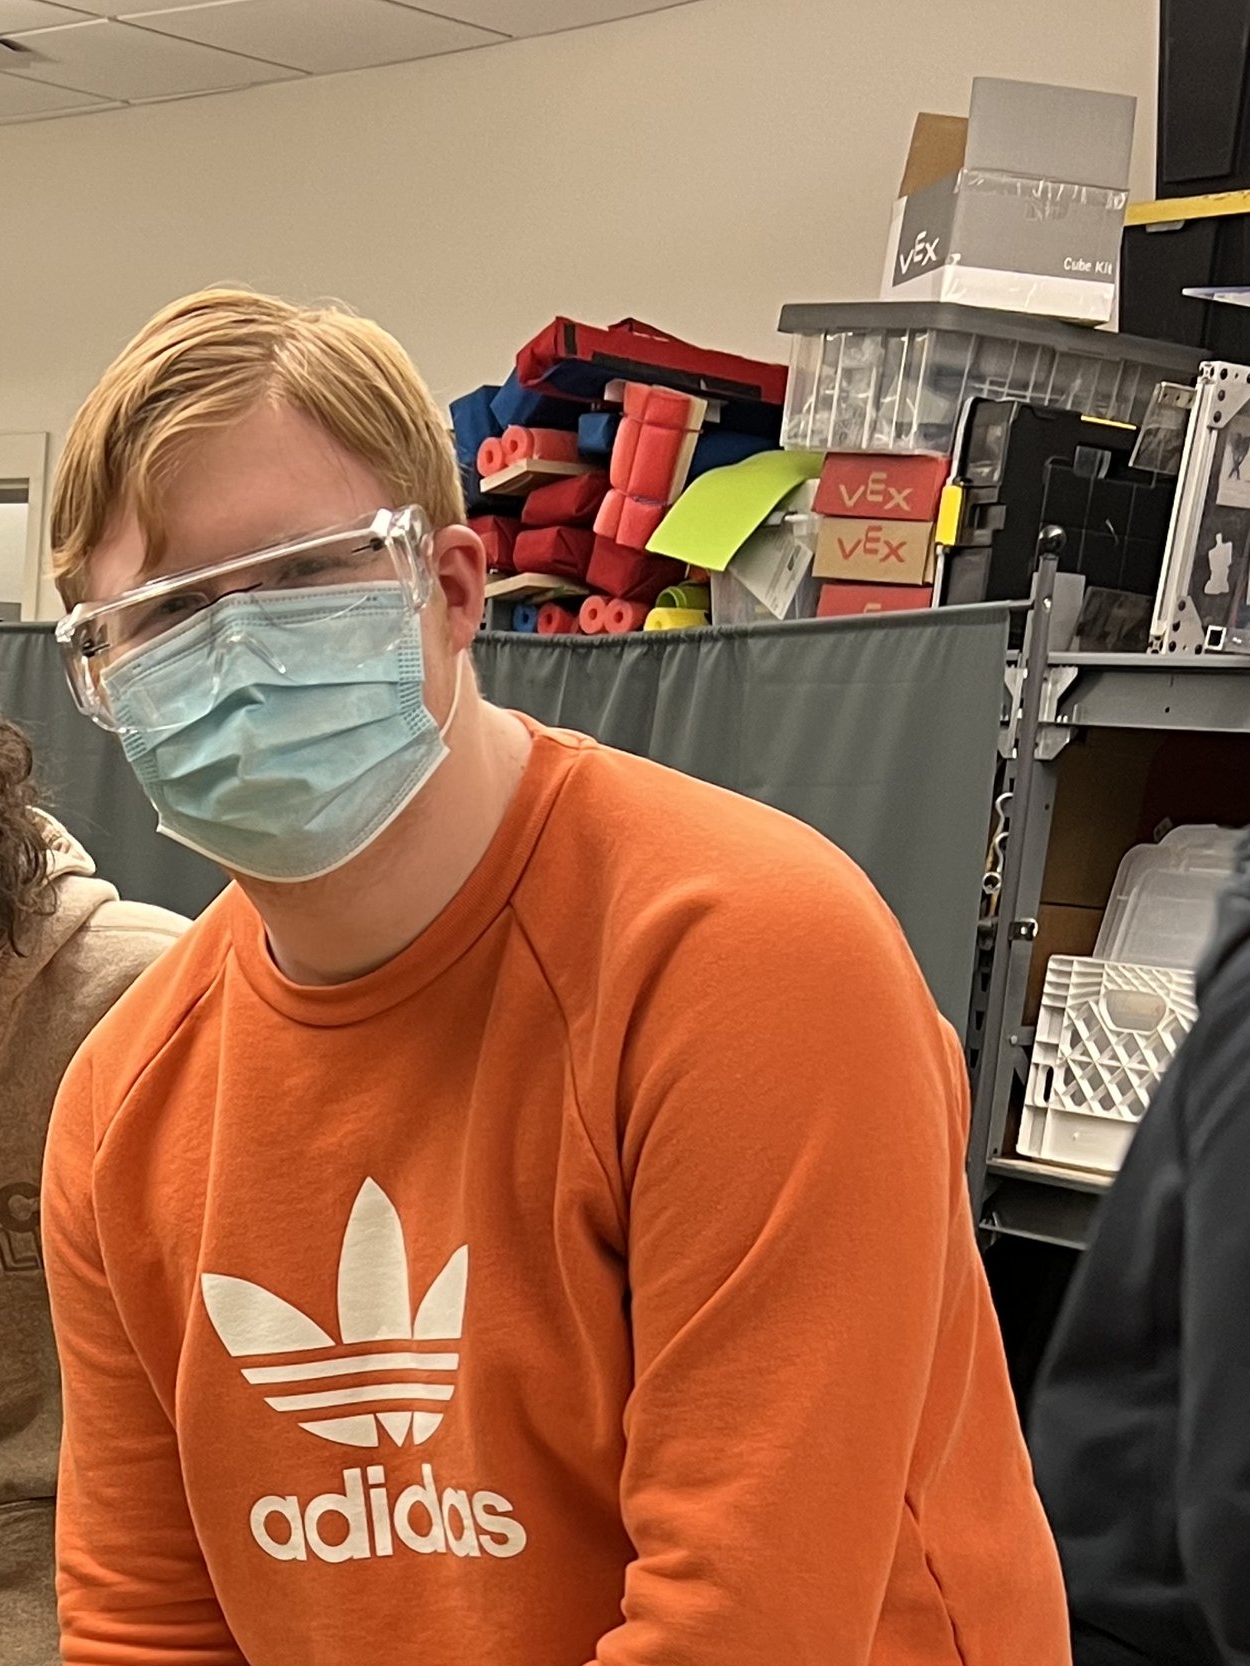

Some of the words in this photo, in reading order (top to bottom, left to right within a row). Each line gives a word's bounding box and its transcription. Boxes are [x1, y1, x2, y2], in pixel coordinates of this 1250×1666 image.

[1063, 257, 1091, 273] Cube
[1095, 259, 1113, 275] Kit
[250, 1463, 527, 1563] adidas
